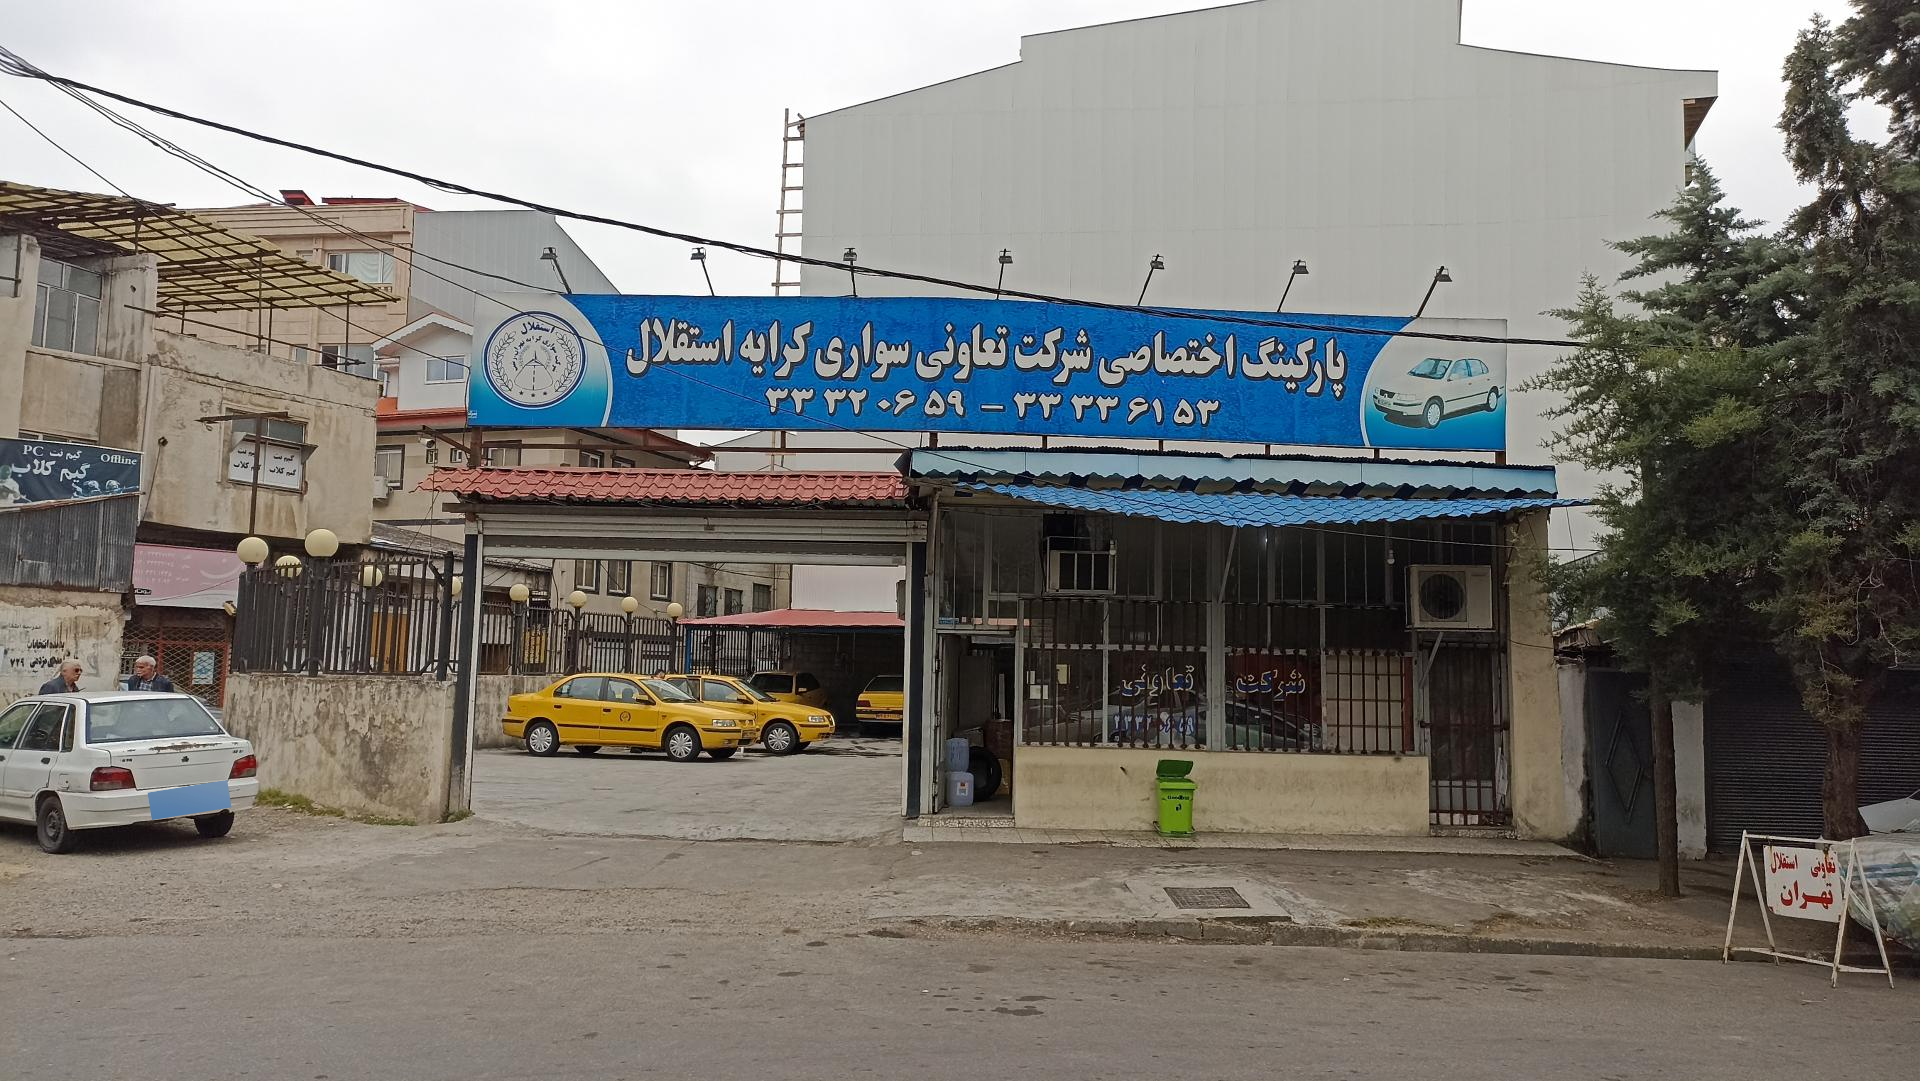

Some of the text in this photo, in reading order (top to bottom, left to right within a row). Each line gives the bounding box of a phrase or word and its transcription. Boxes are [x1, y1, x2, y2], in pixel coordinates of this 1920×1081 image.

[520, 321, 556, 335] استقلال
[626, 317, 1347, 399] پارکینگ اختصاصی شرکت تعاونی سواری کرایه استقلال
[22, 444, 44, 457] PC
[49, 448, 64, 457] نت
[100, 453, 138, 466] Offline
[233, 460, 250, 469] کلاب
[11, 458, 91, 482] گیم کلاب
[269, 466, 285, 475] کلاب
[1121, 664, 1306, 702] شرکت تعاونی
[1770, 851, 1836, 879] تعاونی استقلال
[1780, 879, 1834, 910] تهران
